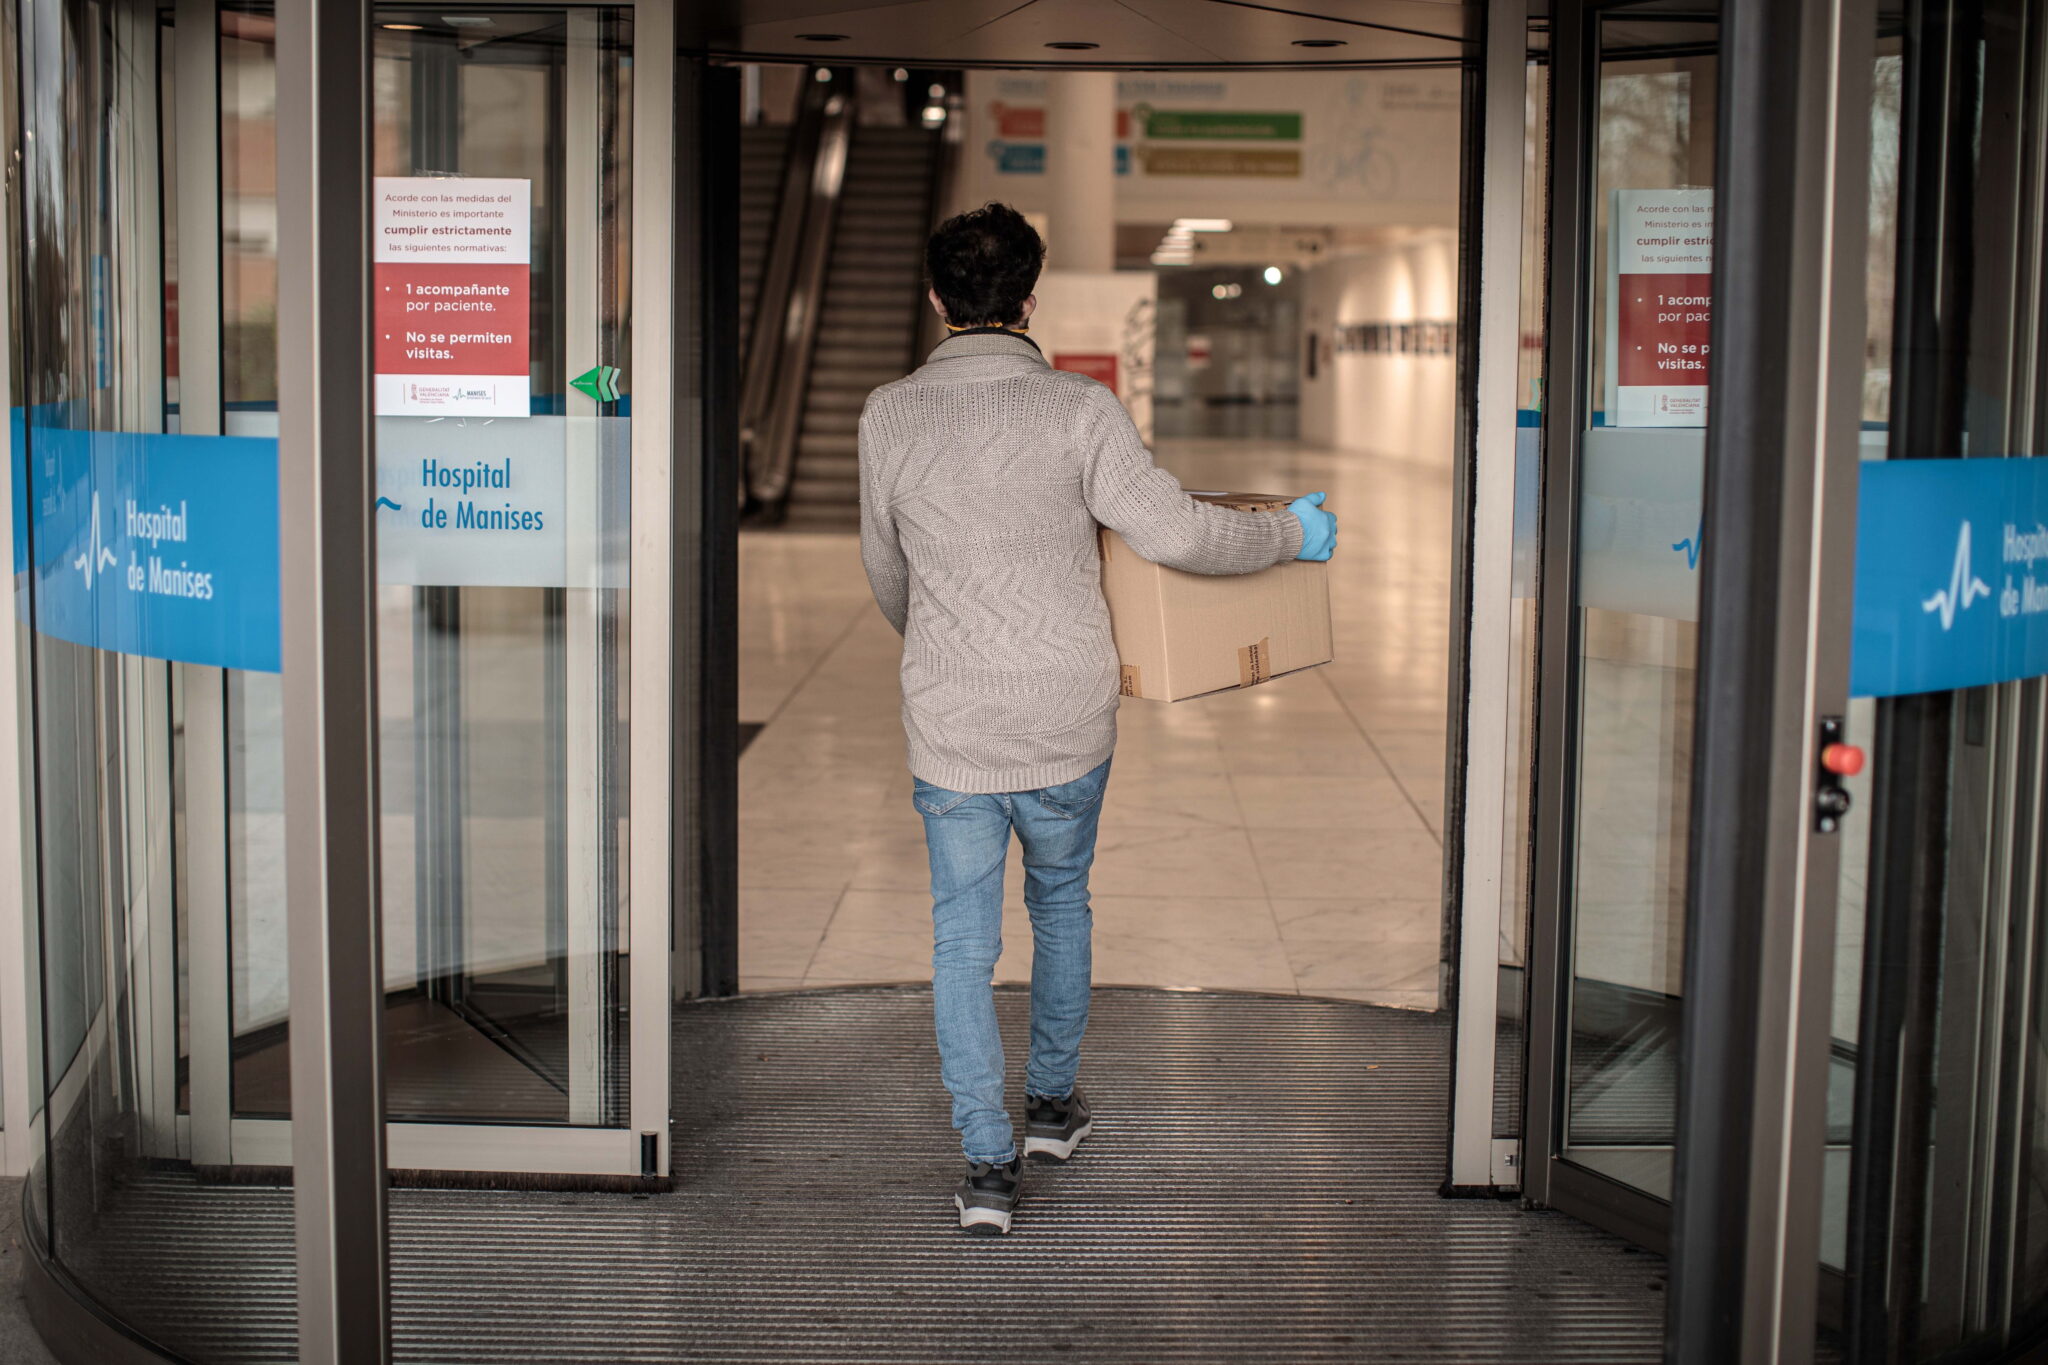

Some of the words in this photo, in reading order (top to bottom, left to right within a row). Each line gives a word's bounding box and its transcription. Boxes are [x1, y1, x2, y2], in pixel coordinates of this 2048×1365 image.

[385, 194, 419, 203] Acorde
[456, 194, 497, 203] medidas
[500, 195, 512, 203] del
[393, 210, 437, 218] Ministerio
[453, 210, 504, 219] importante
[1637, 205, 1670, 213] Acorde
[1692, 205, 1705, 213] las
[1645, 220, 1689, 228] Ministerio
[384, 226, 428, 236] cumplir
[432, 227, 512, 236] estrictamente
[1637, 236, 1680, 247] cumplir
[389, 244, 402, 252] las
[405, 244, 450, 254] siguientes
[454, 244, 506, 252] normativas:
[1657, 255, 1703, 264] siguientes
[406, 284, 412, 295] 1
[416, 284, 510, 297] acompañante
[1658, 295, 1663, 305] 1
[406, 301, 429, 313] por
[434, 301, 496, 312] paciente.
[1658, 312, 1681, 323] por
[406, 332, 425, 343] No
[430, 334, 445, 343] se
[450, 332, 512, 345] permiten
[406, 347, 454, 359] visitas.
[1658, 343, 1677, 353] No
[1682, 345, 1697, 353] se
[1658, 358, 1705, 369] visitas.
[423, 458, 511, 495] Hospital
[422, 498, 447, 529] de
[456, 501, 543, 530] Manises
[126, 499, 187, 549] Hospital
[127, 551, 144, 591] de
[149, 556, 213, 600] Manises
[2000, 574, 2019, 617] de
